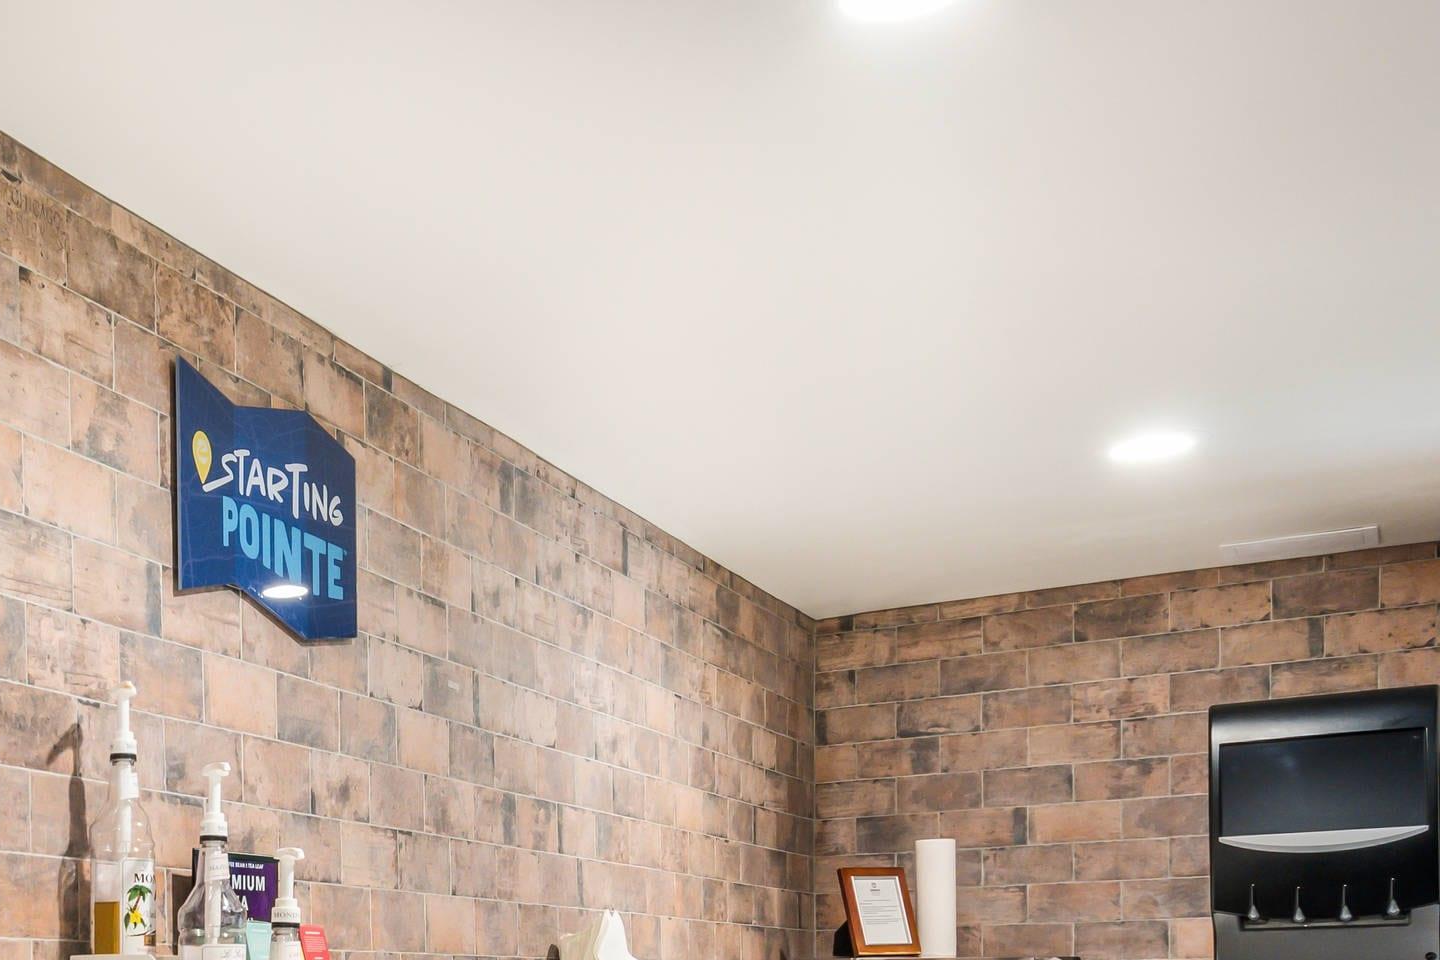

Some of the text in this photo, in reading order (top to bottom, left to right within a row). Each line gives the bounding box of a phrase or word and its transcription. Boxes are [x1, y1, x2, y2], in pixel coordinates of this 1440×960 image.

[202, 448, 344, 527] STARTING
[222, 495, 345, 601] POINTE
[231, 874, 266, 892] MIUM
